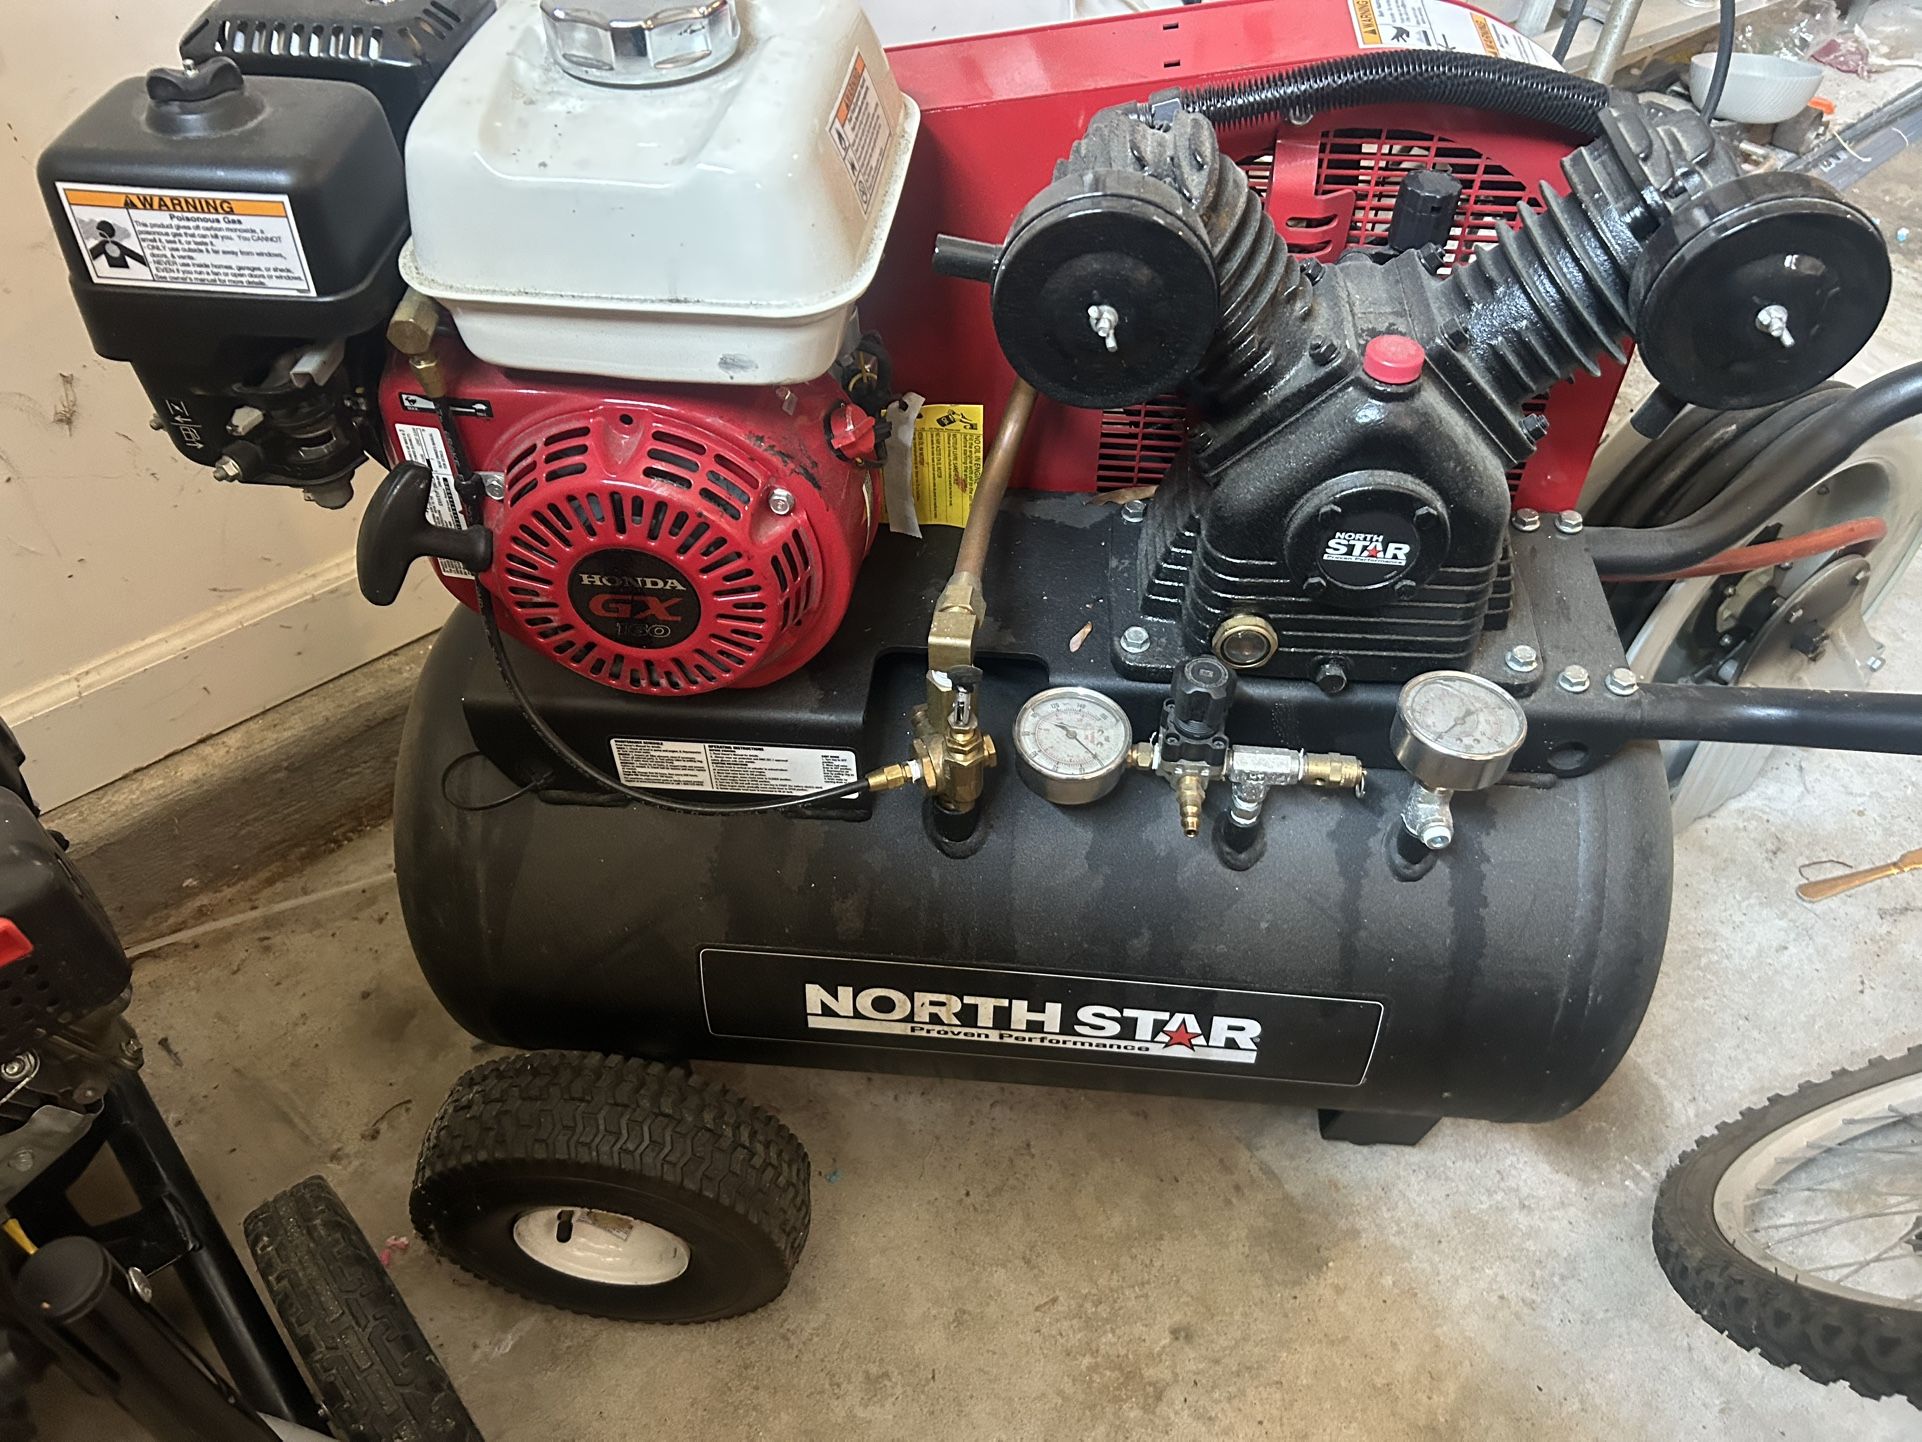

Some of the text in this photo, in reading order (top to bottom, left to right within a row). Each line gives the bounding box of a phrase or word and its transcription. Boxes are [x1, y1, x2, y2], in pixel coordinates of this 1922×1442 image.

[137, 195, 234, 214] WARNING
[169, 213, 243, 225] Poisonous Gas
[1335, 532, 1384, 541] NORTH
[1325, 539, 1411, 560] STAR
[580, 573, 686, 590] HONDA
[588, 593, 683, 621] GX
[805, 983, 1262, 1050] NORTH STAR
[910, 1025, 1150, 1052] Proven Performance
